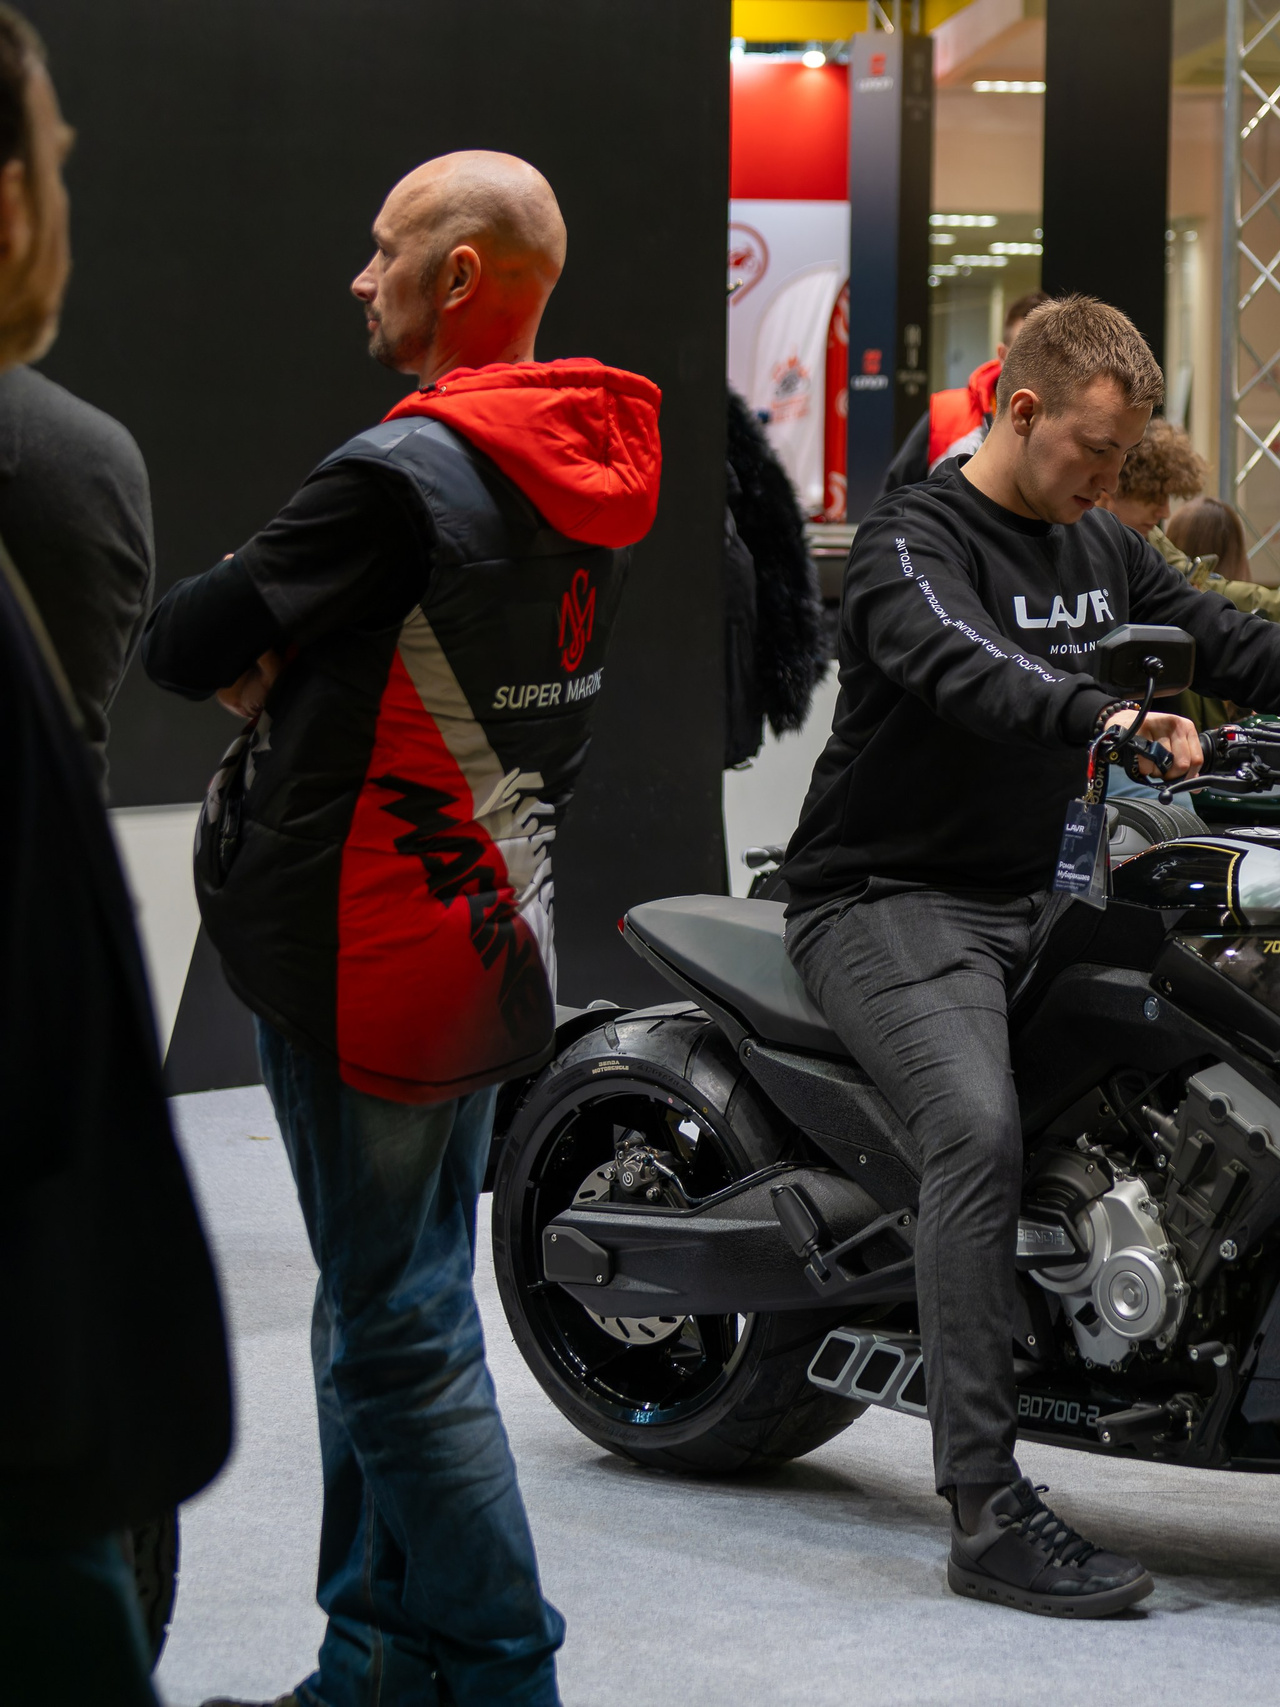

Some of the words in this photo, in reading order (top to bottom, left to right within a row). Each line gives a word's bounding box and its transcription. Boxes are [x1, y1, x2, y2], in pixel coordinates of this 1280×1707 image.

[918, 579, 949, 622] MOTOLINE
[1013, 589, 1115, 629] LAVR
[1050, 640, 1101, 655] MOTOLIN
[492, 682, 562, 709] SUPER
[1065, 823, 1085, 833] LAVR
[591, 1065, 630, 1075] MOTORCYCLE
[1017, 1394, 1100, 1428] BD700-2
